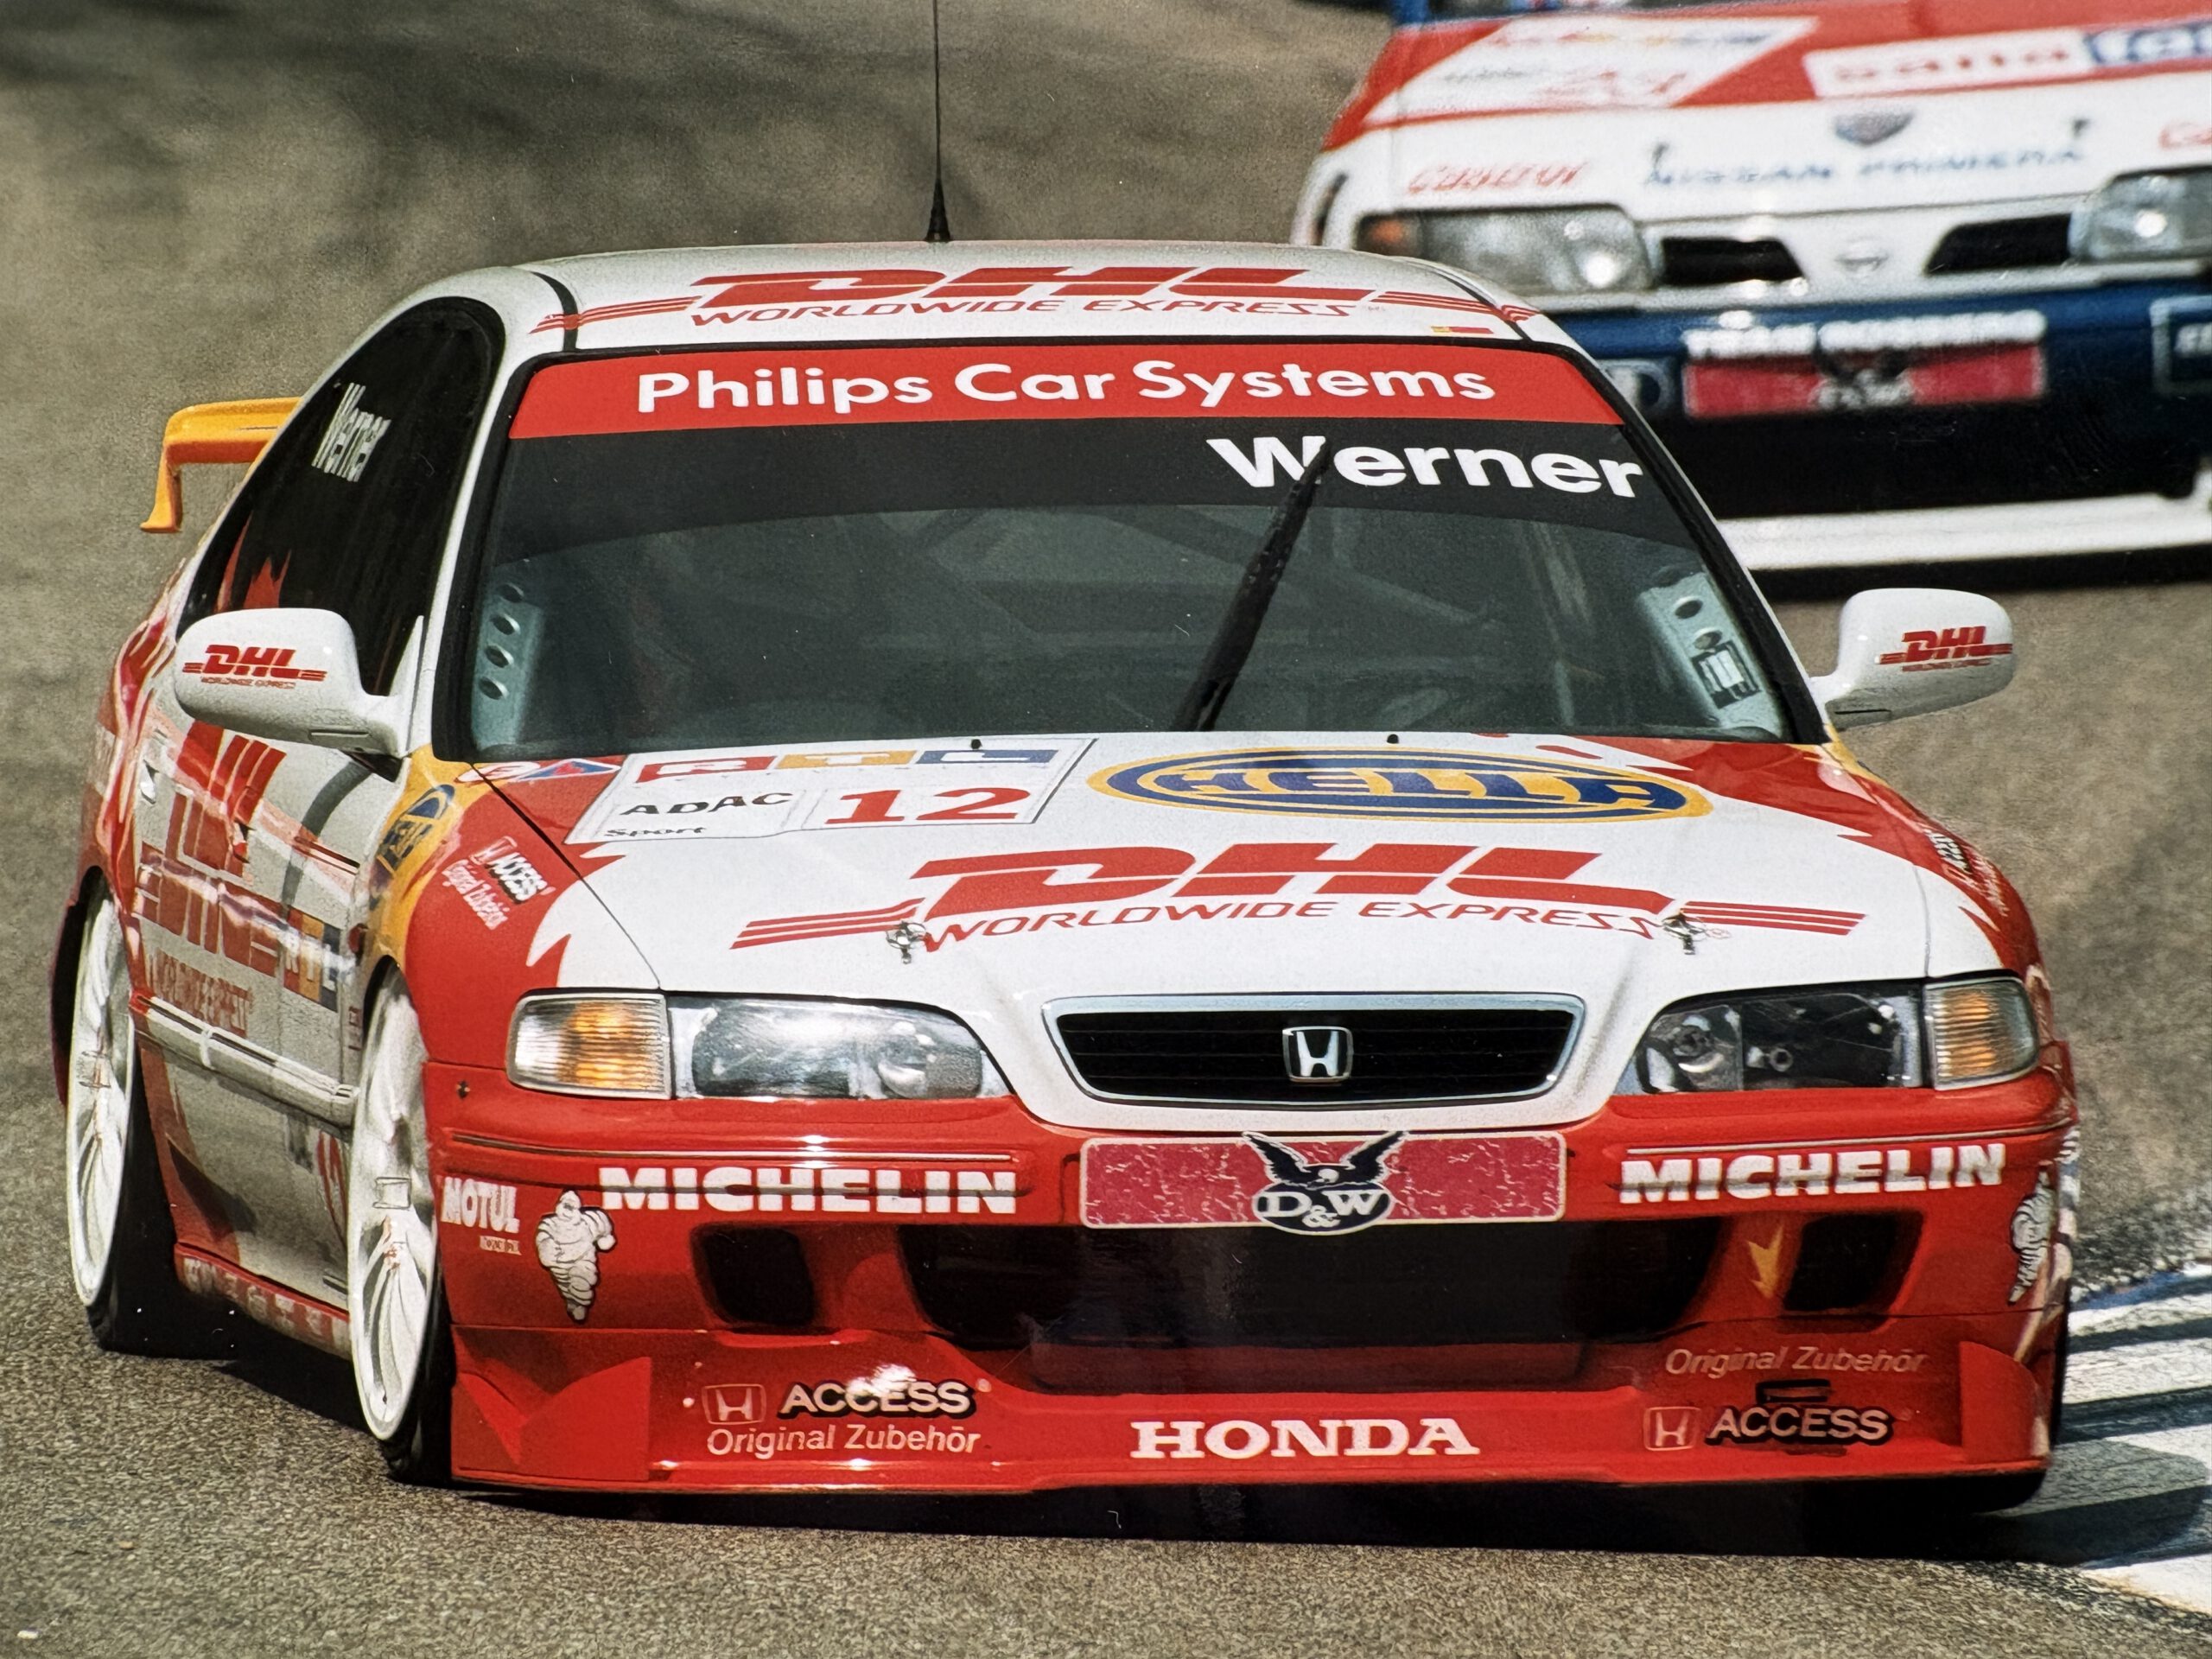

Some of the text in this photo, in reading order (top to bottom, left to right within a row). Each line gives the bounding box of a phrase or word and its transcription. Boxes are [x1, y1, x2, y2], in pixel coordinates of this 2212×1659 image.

[690, 266, 1376, 308] DHL
[690, 299, 1357, 327] WORLDWIDE EXPRESS
[638, 359, 1496, 414] Philips Car Systems
[1206, 435, 1643, 499] Werner
[202, 644, 301, 679] DHL
[1901, 626, 1991, 664] DHL
[619, 792, 794, 816] ADAC
[823, 787, 1031, 825] 12
[1152, 765, 1689, 814] HELLA
[604, 826, 708, 838] Sport
[909, 842, 1675, 922] DHL
[921, 900, 1664, 953] WORLDWIDE EXPRESS
[598, 1166, 1017, 1214] MICHELIN
[1619, 1143, 2006, 1204] MICHELIN
[441, 1176, 520, 1234] MOTUL
[1265, 1189, 1381, 1229] D&W
[1665, 1345, 1929, 1378] Original Zubehör
[779, 1382, 975, 1417] ACCESS
[707, 1423, 982, 1459] Original Zubehör
[1129, 1417, 1480, 1459] HONDA
[1706, 1405, 1892, 1442] ACCESS
